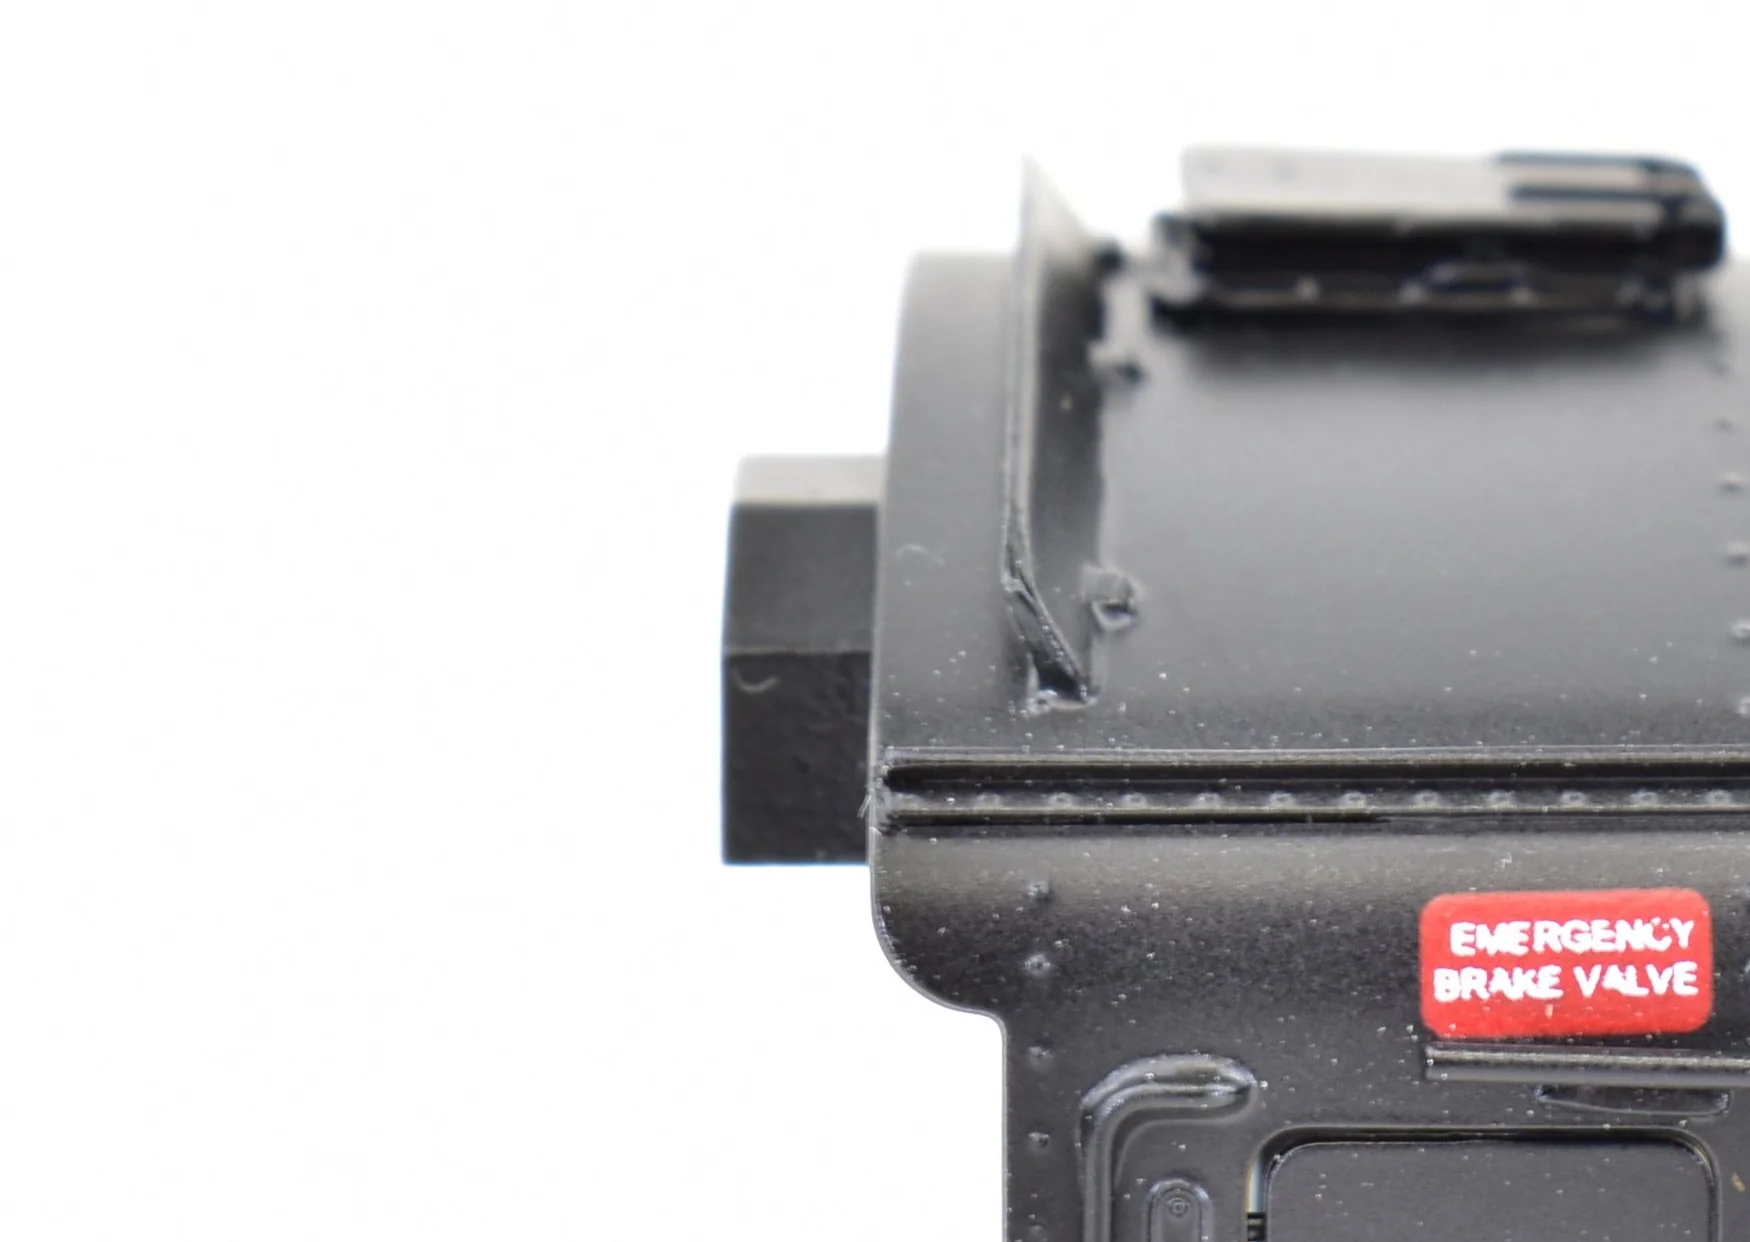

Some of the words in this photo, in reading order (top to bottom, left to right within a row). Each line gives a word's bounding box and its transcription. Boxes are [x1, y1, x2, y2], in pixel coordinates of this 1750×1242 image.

[1448, 916, 1696, 957] EMERGENCY
[1432, 964, 1564, 1004] BRAKE
[1572, 960, 1699, 998] VALVE
